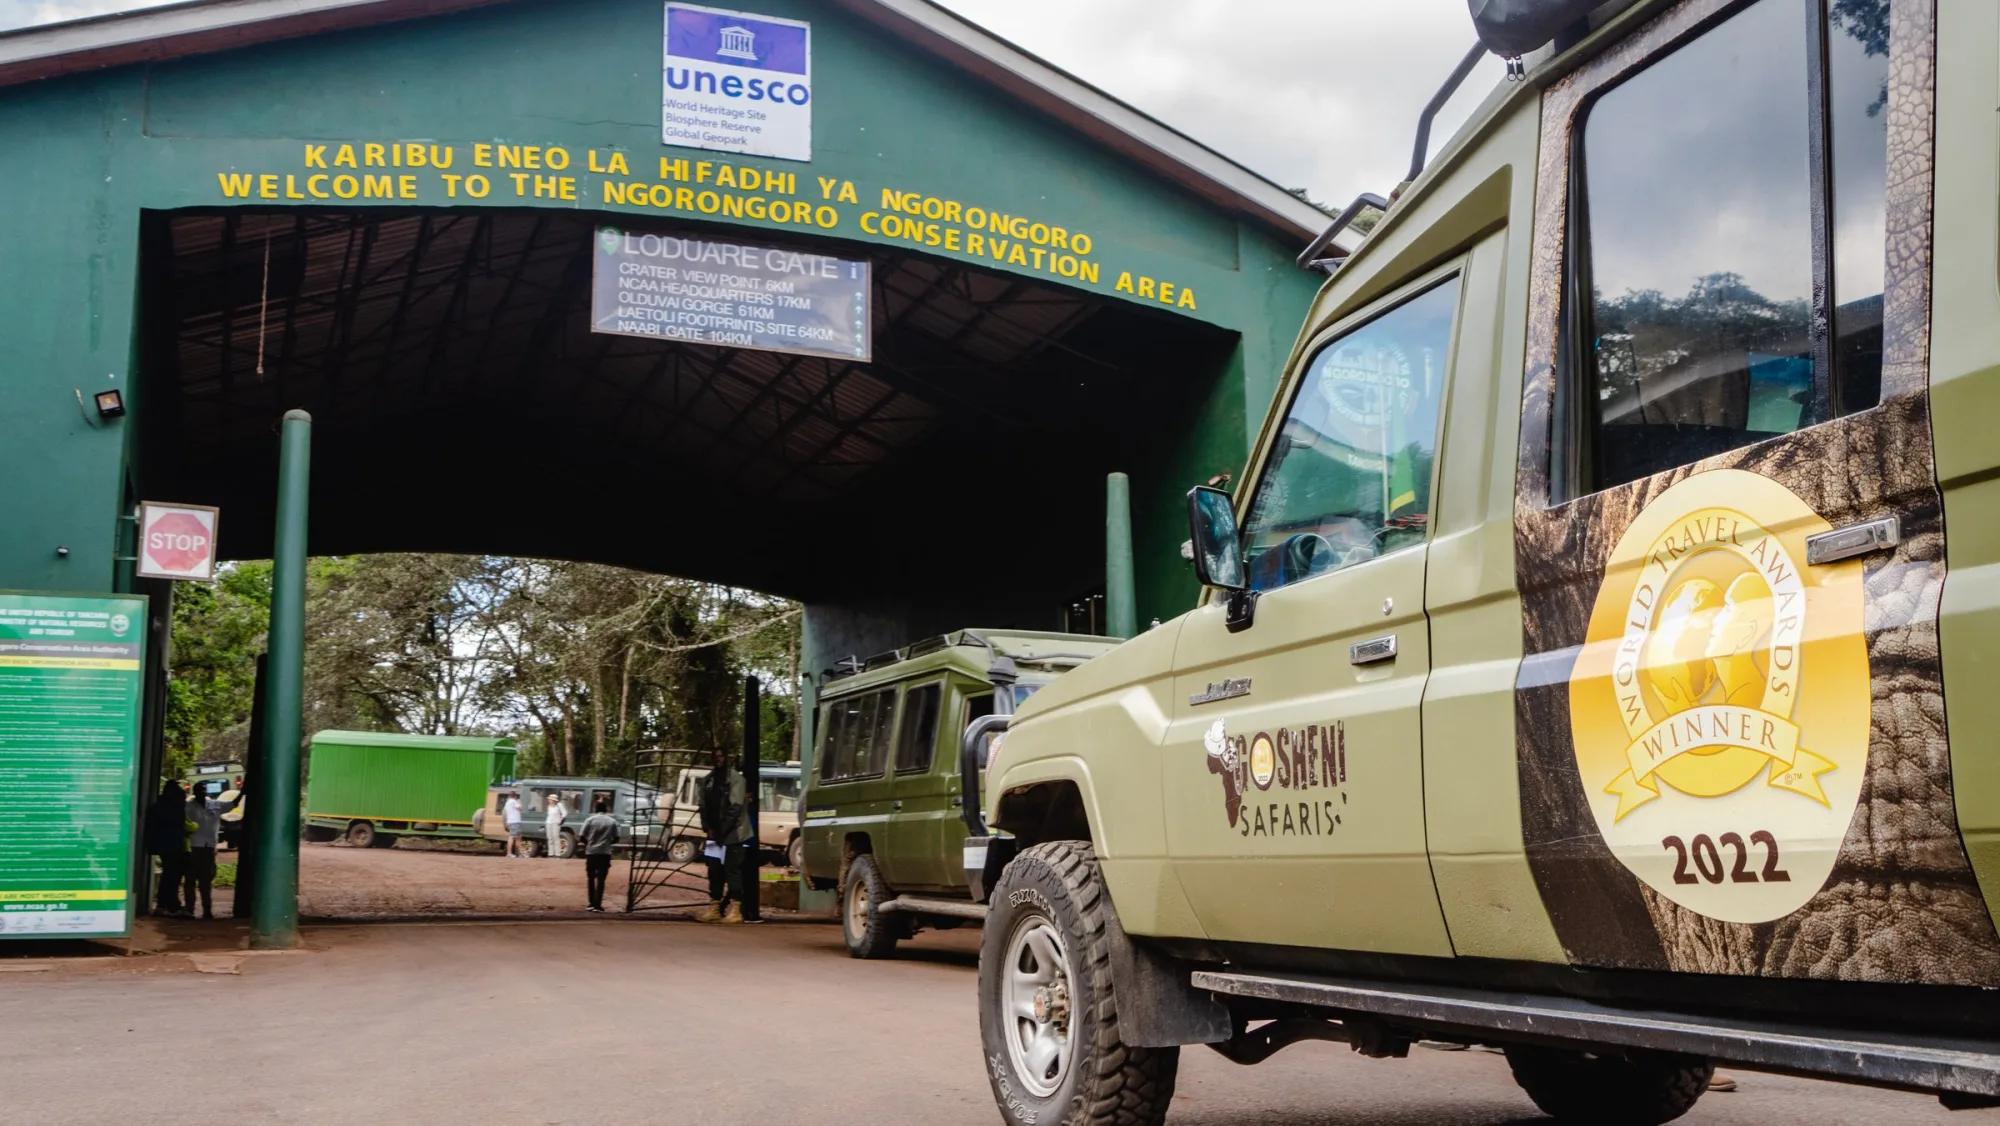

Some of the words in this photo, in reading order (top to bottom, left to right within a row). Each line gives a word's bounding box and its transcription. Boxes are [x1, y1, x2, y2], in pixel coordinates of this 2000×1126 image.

[666, 67, 809, 106] unesco
[666, 98, 698, 112] World
[700, 104, 745, 119] Heritage
[747, 109, 766, 121] Site
[666, 113, 718, 129] Biosphere
[721, 120, 762, 134] Reserve
[666, 126, 700, 140] Global
[702, 131, 748, 146] Geopark
[304, 143, 453, 169] KARIBU
[474, 143, 570, 171] ENEO
[588, 150, 629, 175] LA
[659, 157, 796, 195] HIFADHI
[817, 176, 858, 204] YA
[881, 188, 1092, 256] NGORONGORO
[218, 173, 417, 199] WELCOME
[441, 174, 491, 199] TO
[510, 172, 577, 201] THE
[603, 180, 838, 229] NGORONGORO
[860, 211, 1100, 284] CONSERVATION
[1115, 271, 1197, 311] AREA
[624, 231, 760, 270] LODUARE
[765, 249, 839, 280] GATE
[619, 262, 677, 279] CRATER
[682, 269, 718, 285] VIEW
[720, 273, 761, 290] POINT
[765, 279, 794, 294] 6KM
[619, 277, 659, 292] NCAA
[660, 281, 774, 306] HEADQUARTERS
[777, 295, 811, 310] 17KM
[618, 291, 680, 309] OLDUVAI
[682, 298, 734, 315] GORGE
[738, 305, 775, 320] 61KM
[618, 306, 676, 323] LAETOLI
[677, 312, 765, 333] FOOTPRINTS
[767, 322, 797, 337] SITE
[798, 326, 834, 341] 64KM
[618, 320, 660, 335] NAABI
[665, 325, 704, 341] GATE
[711, 331, 752, 345] 104KM
[150, 532, 206, 552] STOP
[1616, 584, 1654, 727] WORLD
[1651, 515, 1745, 574] TRAVEL
[1750, 536, 1797, 698] AWARDS
[1641, 711, 1777, 761] WINNER
[1662, 830, 1791, 885] 2022
